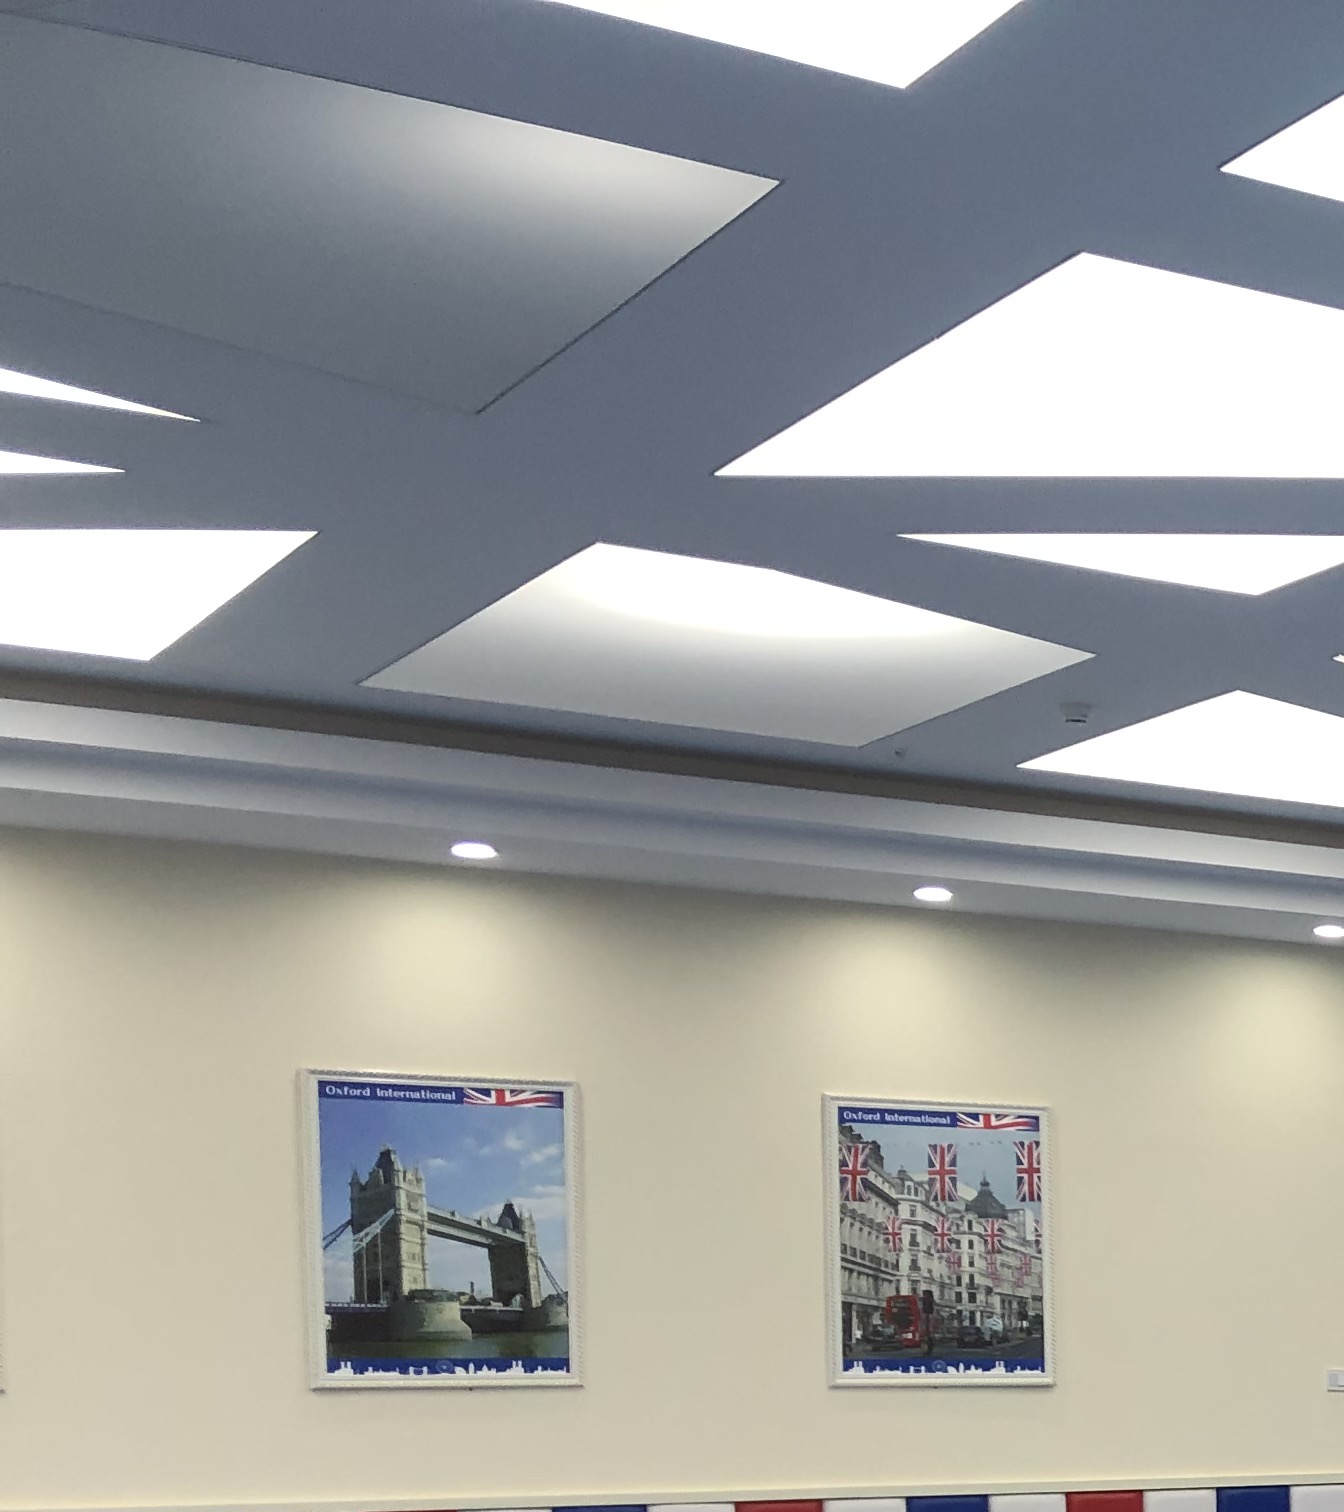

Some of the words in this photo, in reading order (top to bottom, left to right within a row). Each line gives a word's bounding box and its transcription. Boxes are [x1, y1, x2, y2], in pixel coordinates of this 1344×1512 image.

[325, 1084, 371, 1097] Oxford
[376, 1087, 456, 1101] International
[843, 1110, 880, 1121] Oxford
[884, 1112, 951, 1125] International
